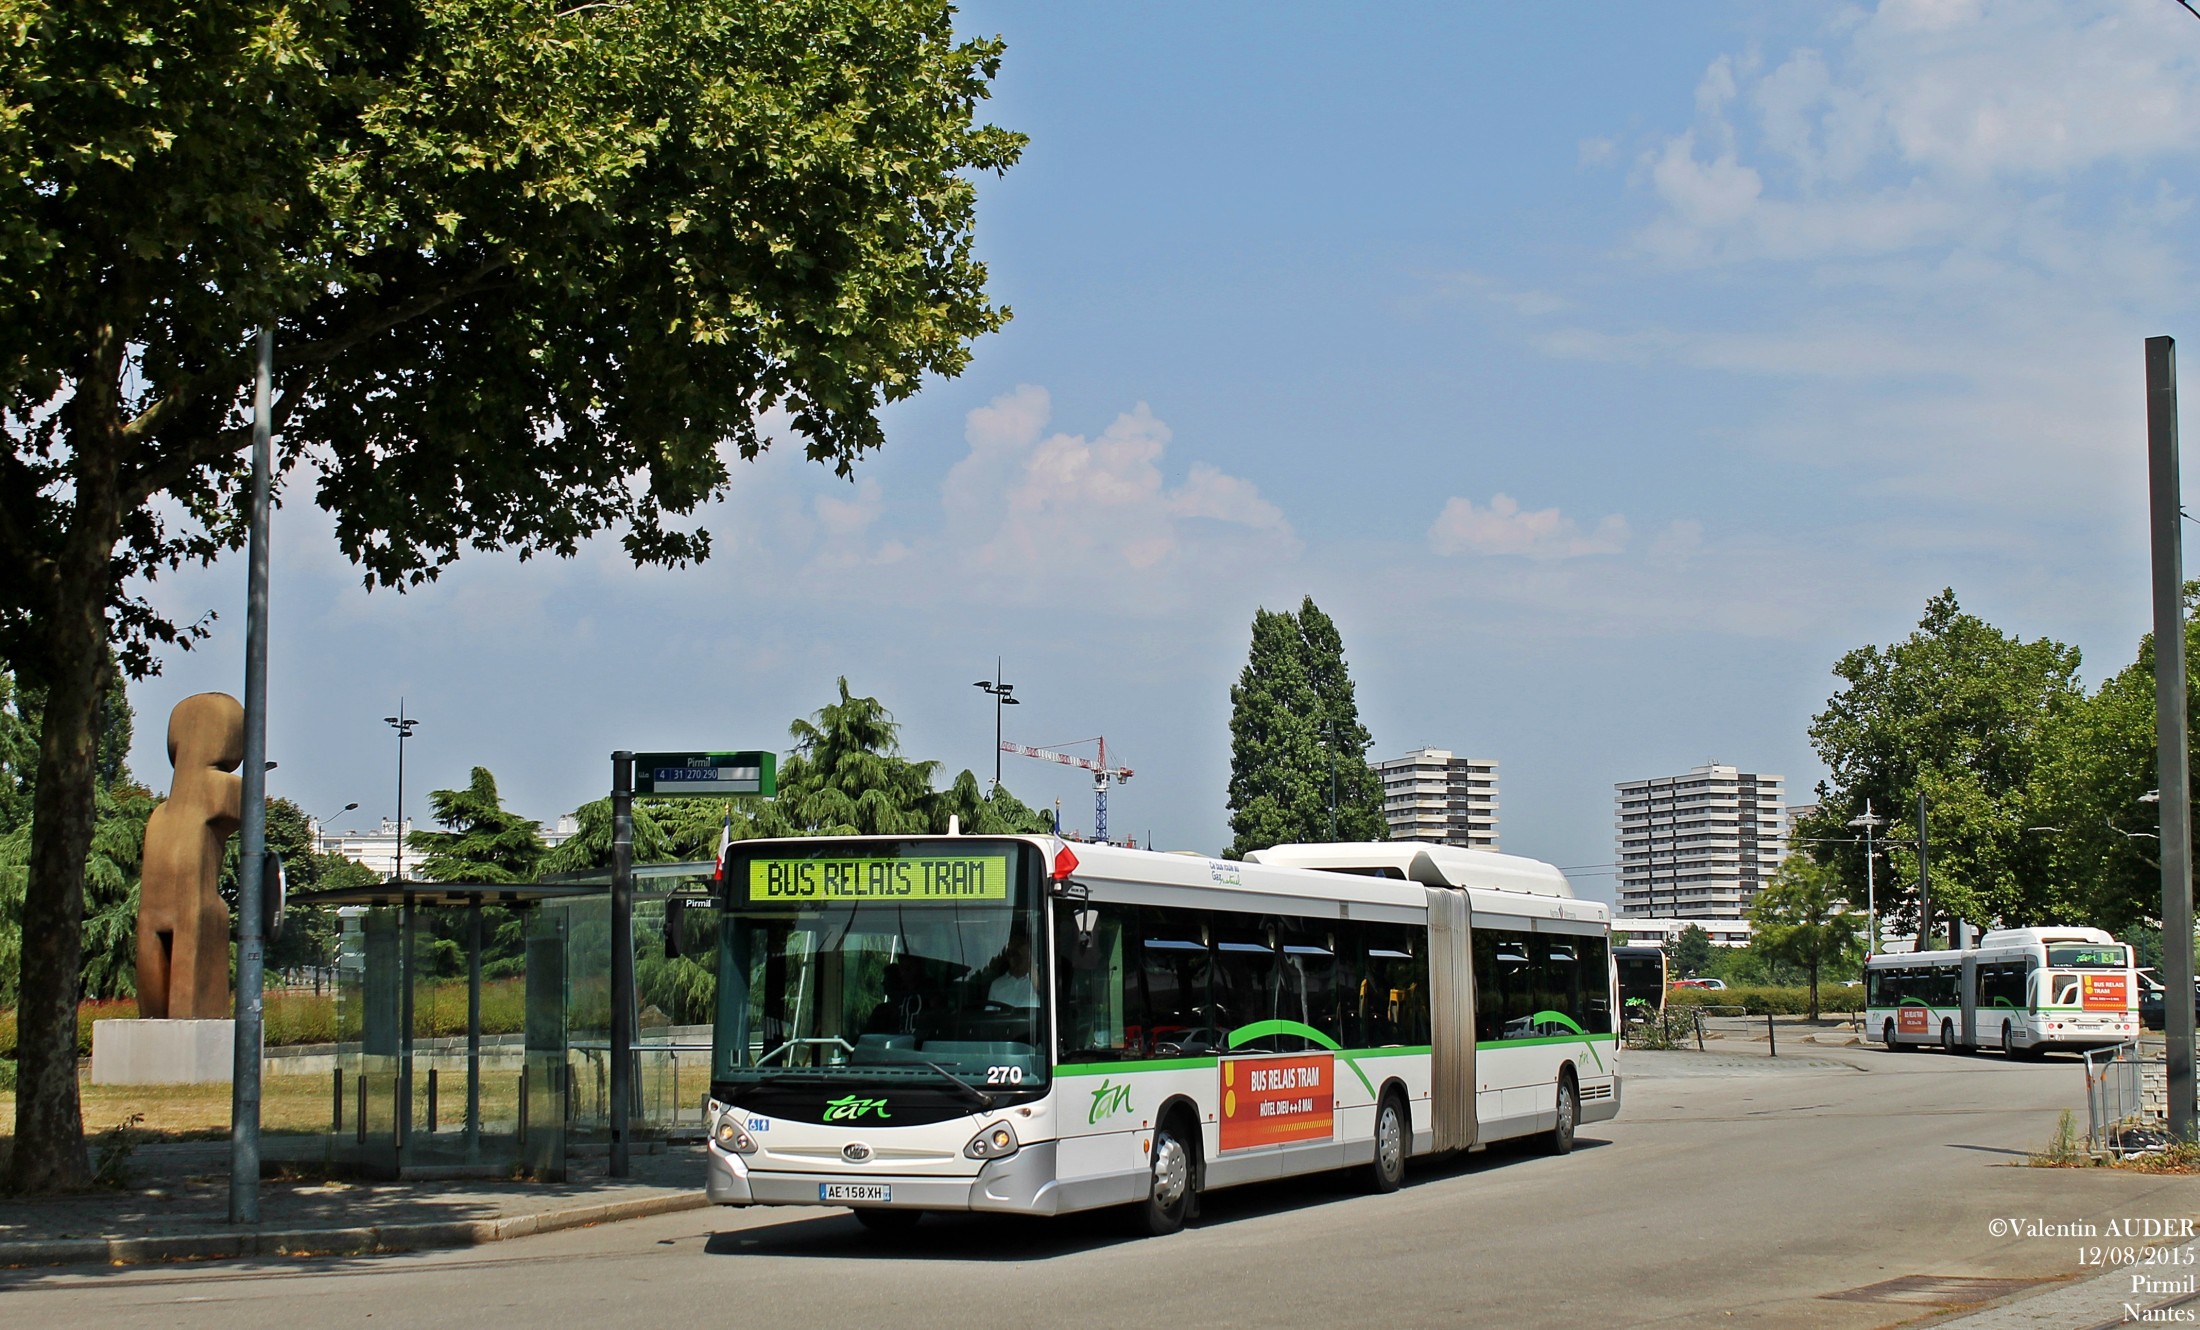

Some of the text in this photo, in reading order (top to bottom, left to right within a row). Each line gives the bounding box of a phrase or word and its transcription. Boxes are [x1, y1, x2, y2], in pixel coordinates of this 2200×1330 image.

[687, 757, 711, 767] Pirmil
[659, 770, 666, 779] 4
[674, 770, 683, 779] 31
[687, 769, 702, 779] 270
[703, 769, 718, 779] 290
[767, 861, 985, 896] BUS RELAIS TRAM
[686, 899, 711, 908] Pirmil
[987, 1066, 1022, 1084] 270
[1251, 1066, 1319, 1092] BUS RELAIS TRAM
[823, 1094, 892, 1121] tan
[1089, 1078, 1135, 1125] tan
[1260, 1098, 1313, 1117] HÔTEL DIEU 8 MAI
